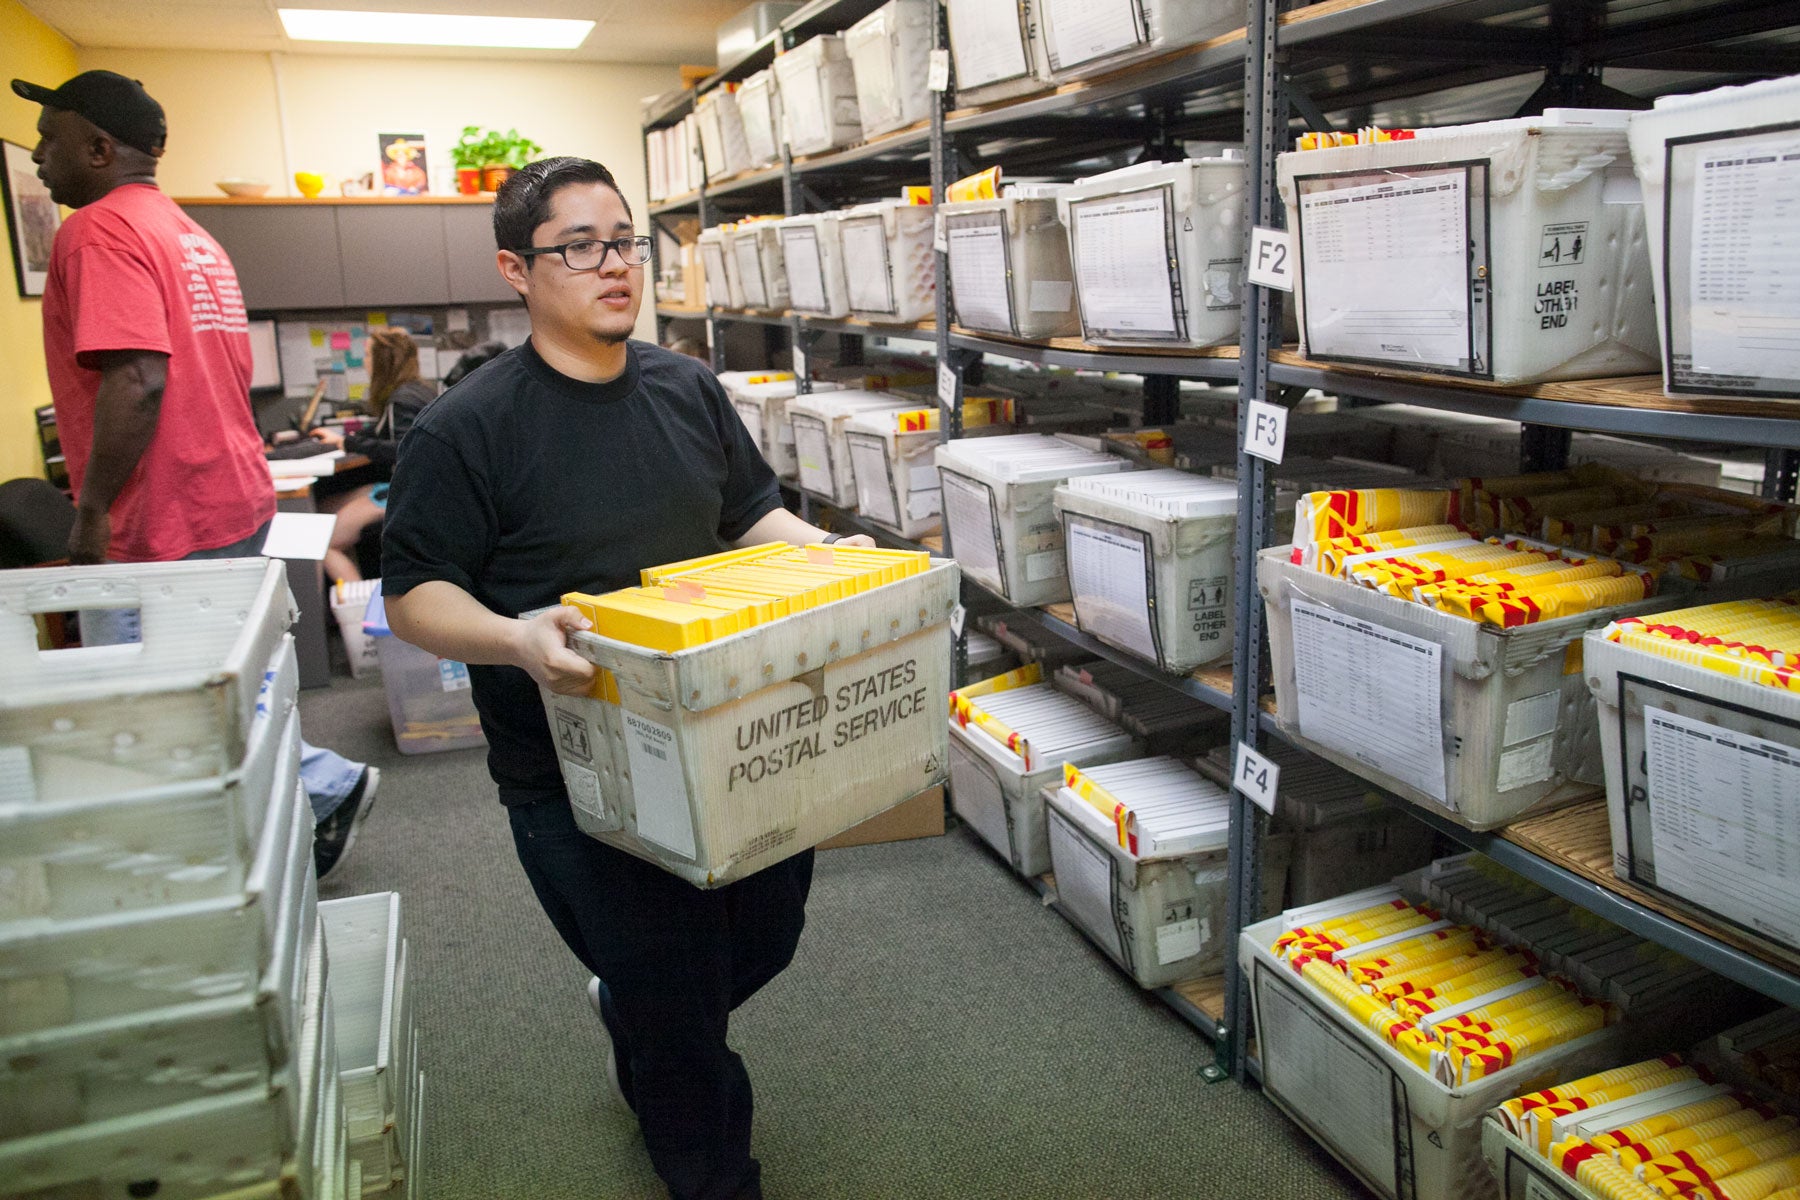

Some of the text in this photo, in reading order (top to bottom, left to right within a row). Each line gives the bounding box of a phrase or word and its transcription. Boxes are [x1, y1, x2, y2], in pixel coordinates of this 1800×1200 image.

[1258, 240, 1286, 274] F2
[1537, 280, 1578, 297] LABEL
[1541, 314, 1567, 330] END
[1255, 413, 1277, 446] F3
[1193, 620, 1226, 632] OTHER
[1195, 611, 1226, 621] LABEL
[1200, 631, 1219, 641] END
[736, 659, 917, 751] UNITED STATES
[727, 687, 927, 792] POSTAL SERVICE
[1243, 755, 1268, 794] F4
